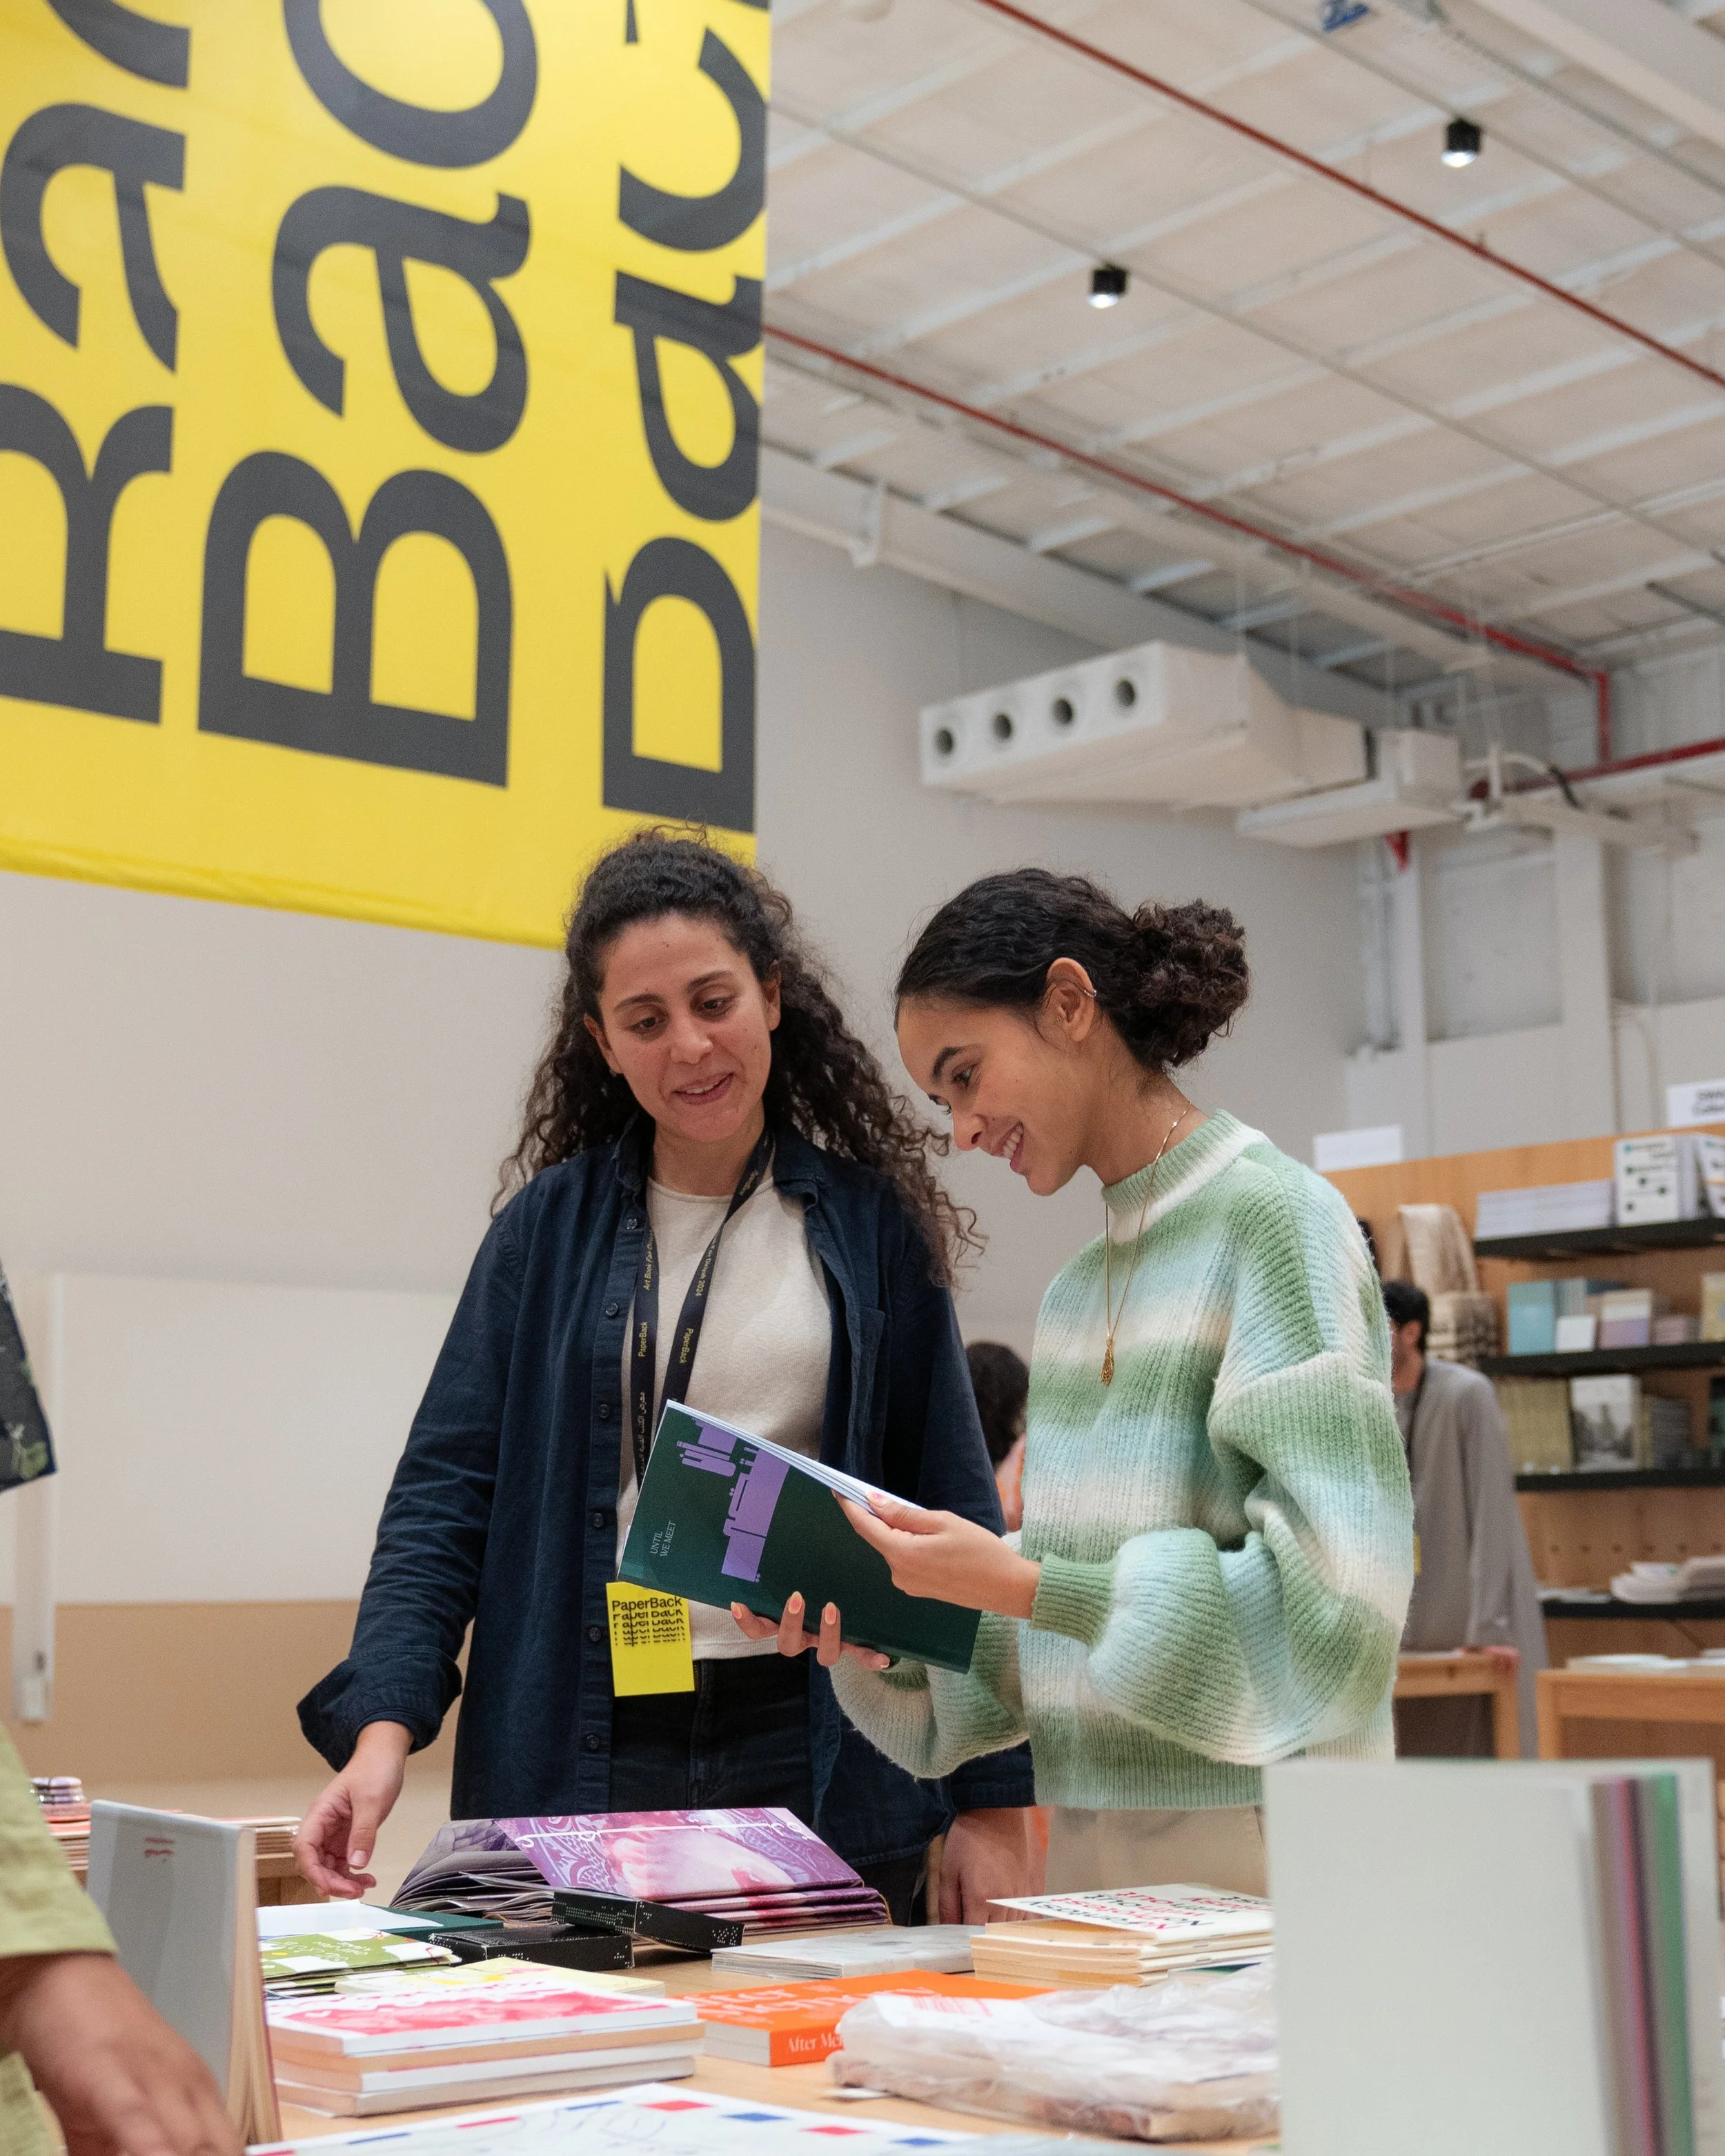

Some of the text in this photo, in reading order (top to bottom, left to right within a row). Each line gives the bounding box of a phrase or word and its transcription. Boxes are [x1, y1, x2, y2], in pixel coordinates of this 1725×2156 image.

[696, 1280, 706, 1296] 2024
[638, 1321, 648, 1358] PaperBack
[680, 1327, 694, 1364] PaperBack
[650, 1531, 663, 1554] UNTIL
[660, 1520, 676, 1556] WE MEET
[612, 1595, 682, 1614] PaperBack
[787, 2036, 817, 2053] After
